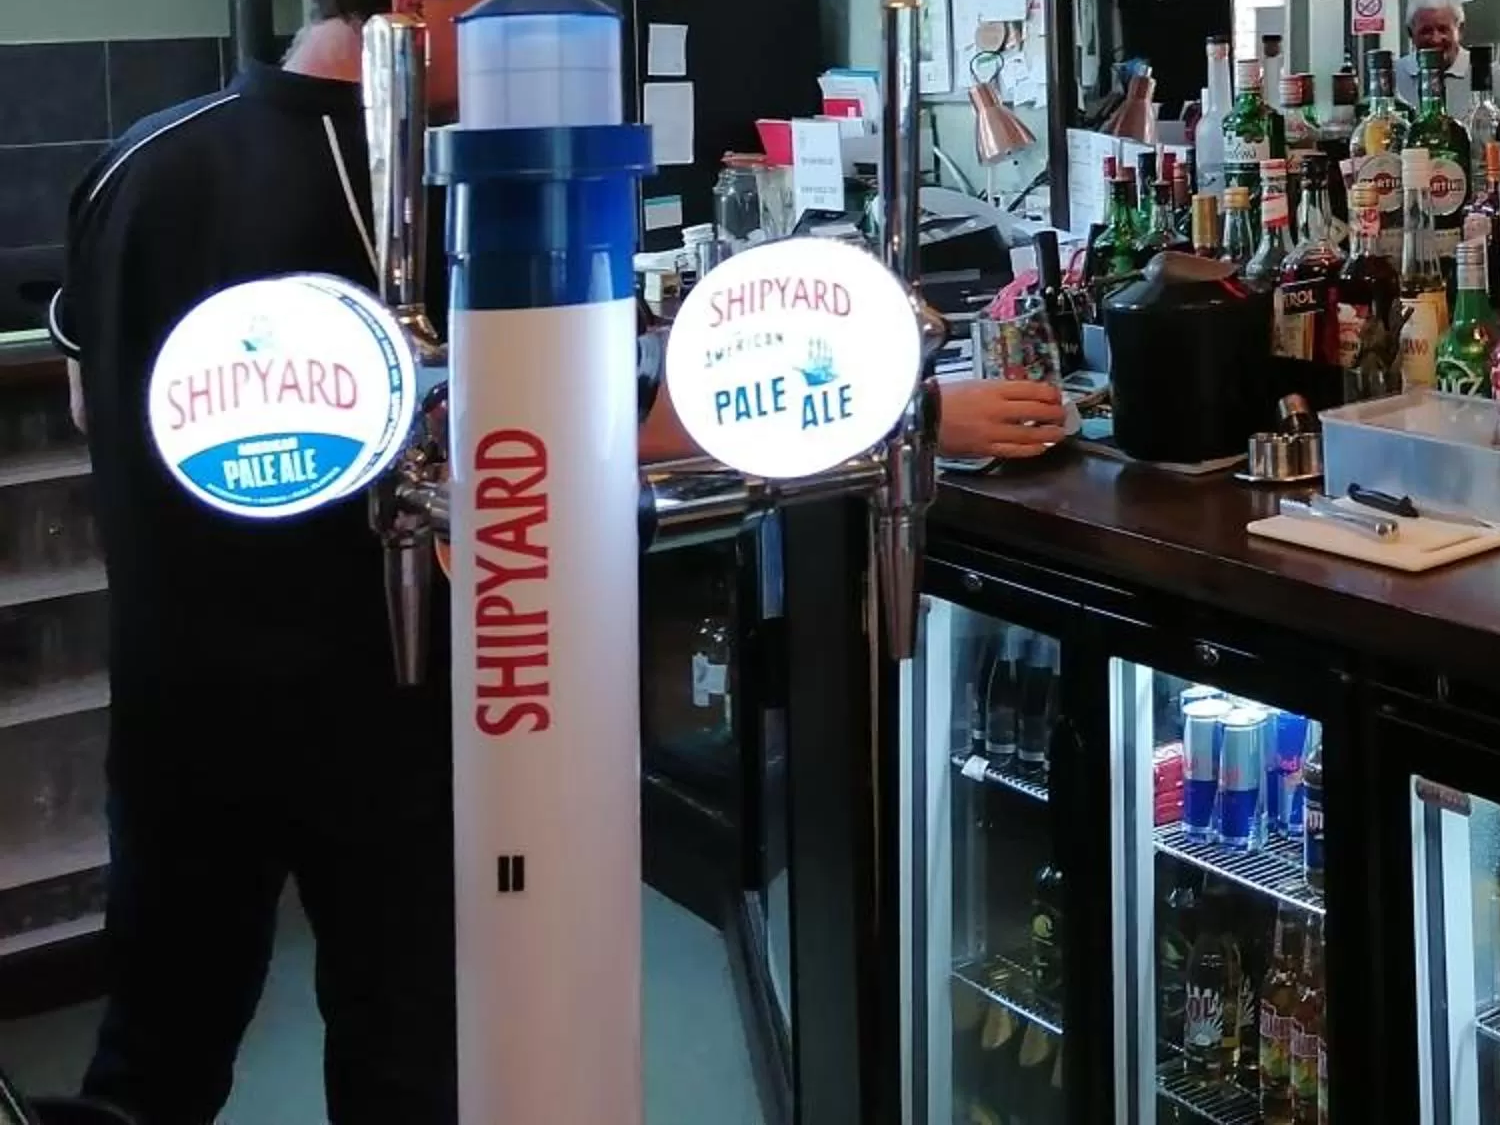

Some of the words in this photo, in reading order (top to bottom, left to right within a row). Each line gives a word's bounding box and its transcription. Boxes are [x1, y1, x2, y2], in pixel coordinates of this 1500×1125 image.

[708, 276, 852, 328] SHIPYARD
[167, 357, 358, 431] SHIPYARD
[714, 376, 788, 426] PALE
[801, 383, 854, 431] ALE
[222, 454, 279, 491] PALE
[279, 447, 319, 484] ALE
[475, 428, 551, 739] SHIPYARD
